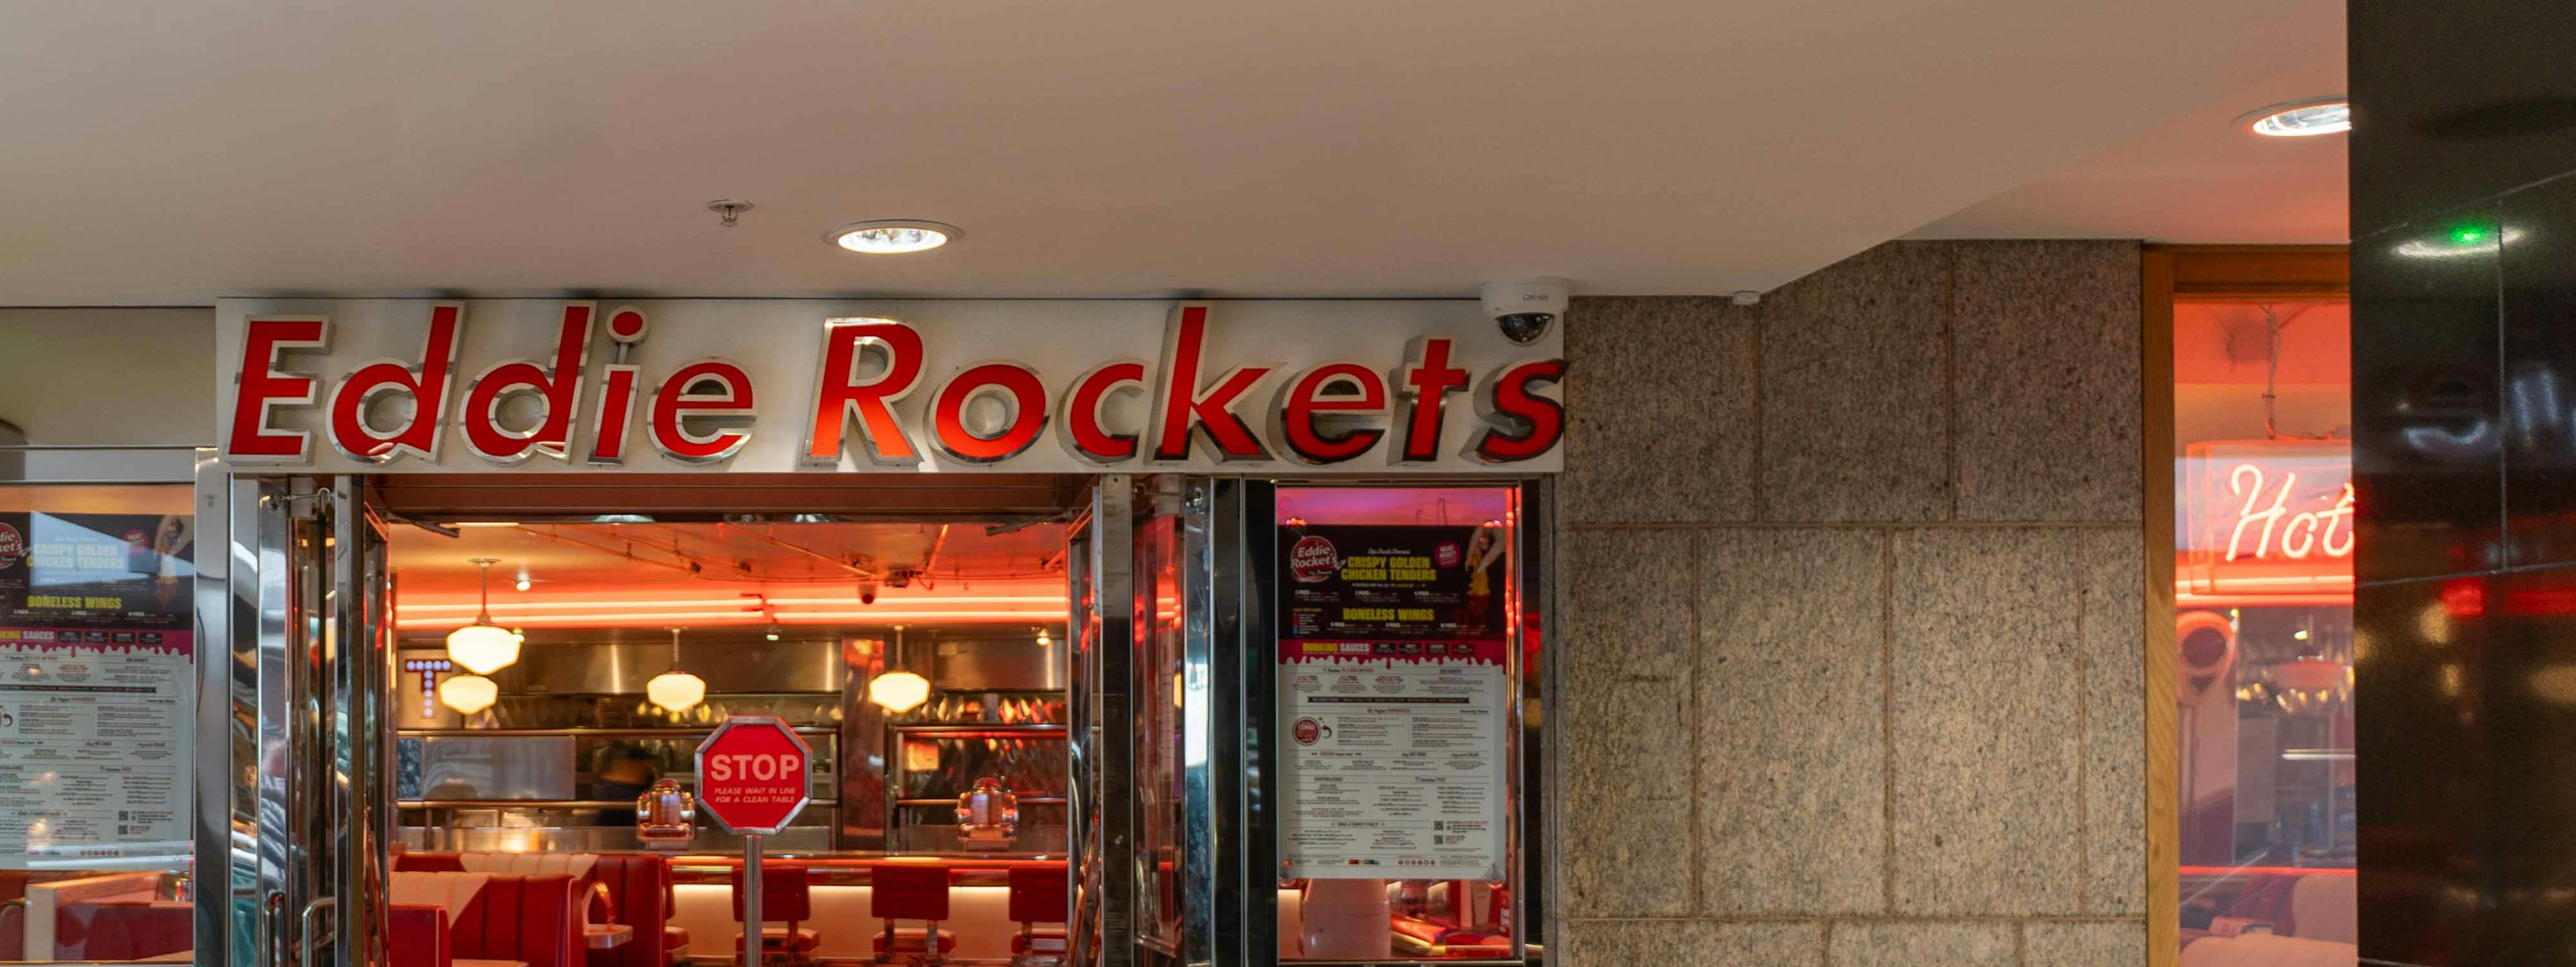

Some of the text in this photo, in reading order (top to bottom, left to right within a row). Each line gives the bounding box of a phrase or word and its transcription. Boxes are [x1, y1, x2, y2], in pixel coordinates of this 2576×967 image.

[225, 301, 1567, 466] Eddie Rockets
[1298, 542, 1330, 557] Eddie
[1291, 553, 1336, 569] Rocket's
[1347, 556, 1430, 569] CRISPY GOLDEN
[1341, 569, 1387, 580] CHICKEN
[1390, 569, 1437, 581] TENDERS
[28, 596, 122, 609] BONELESS WINGS
[1342, 608, 1434, 621] BONELESS WINGS
[1340, 643, 1370, 652] SAUCES
[711, 754, 800, 780] STOP
[714, 787, 741, 795] PLEASE
[715, 795, 731, 803] FOR
[743, 795, 768, 803] CLEAN
